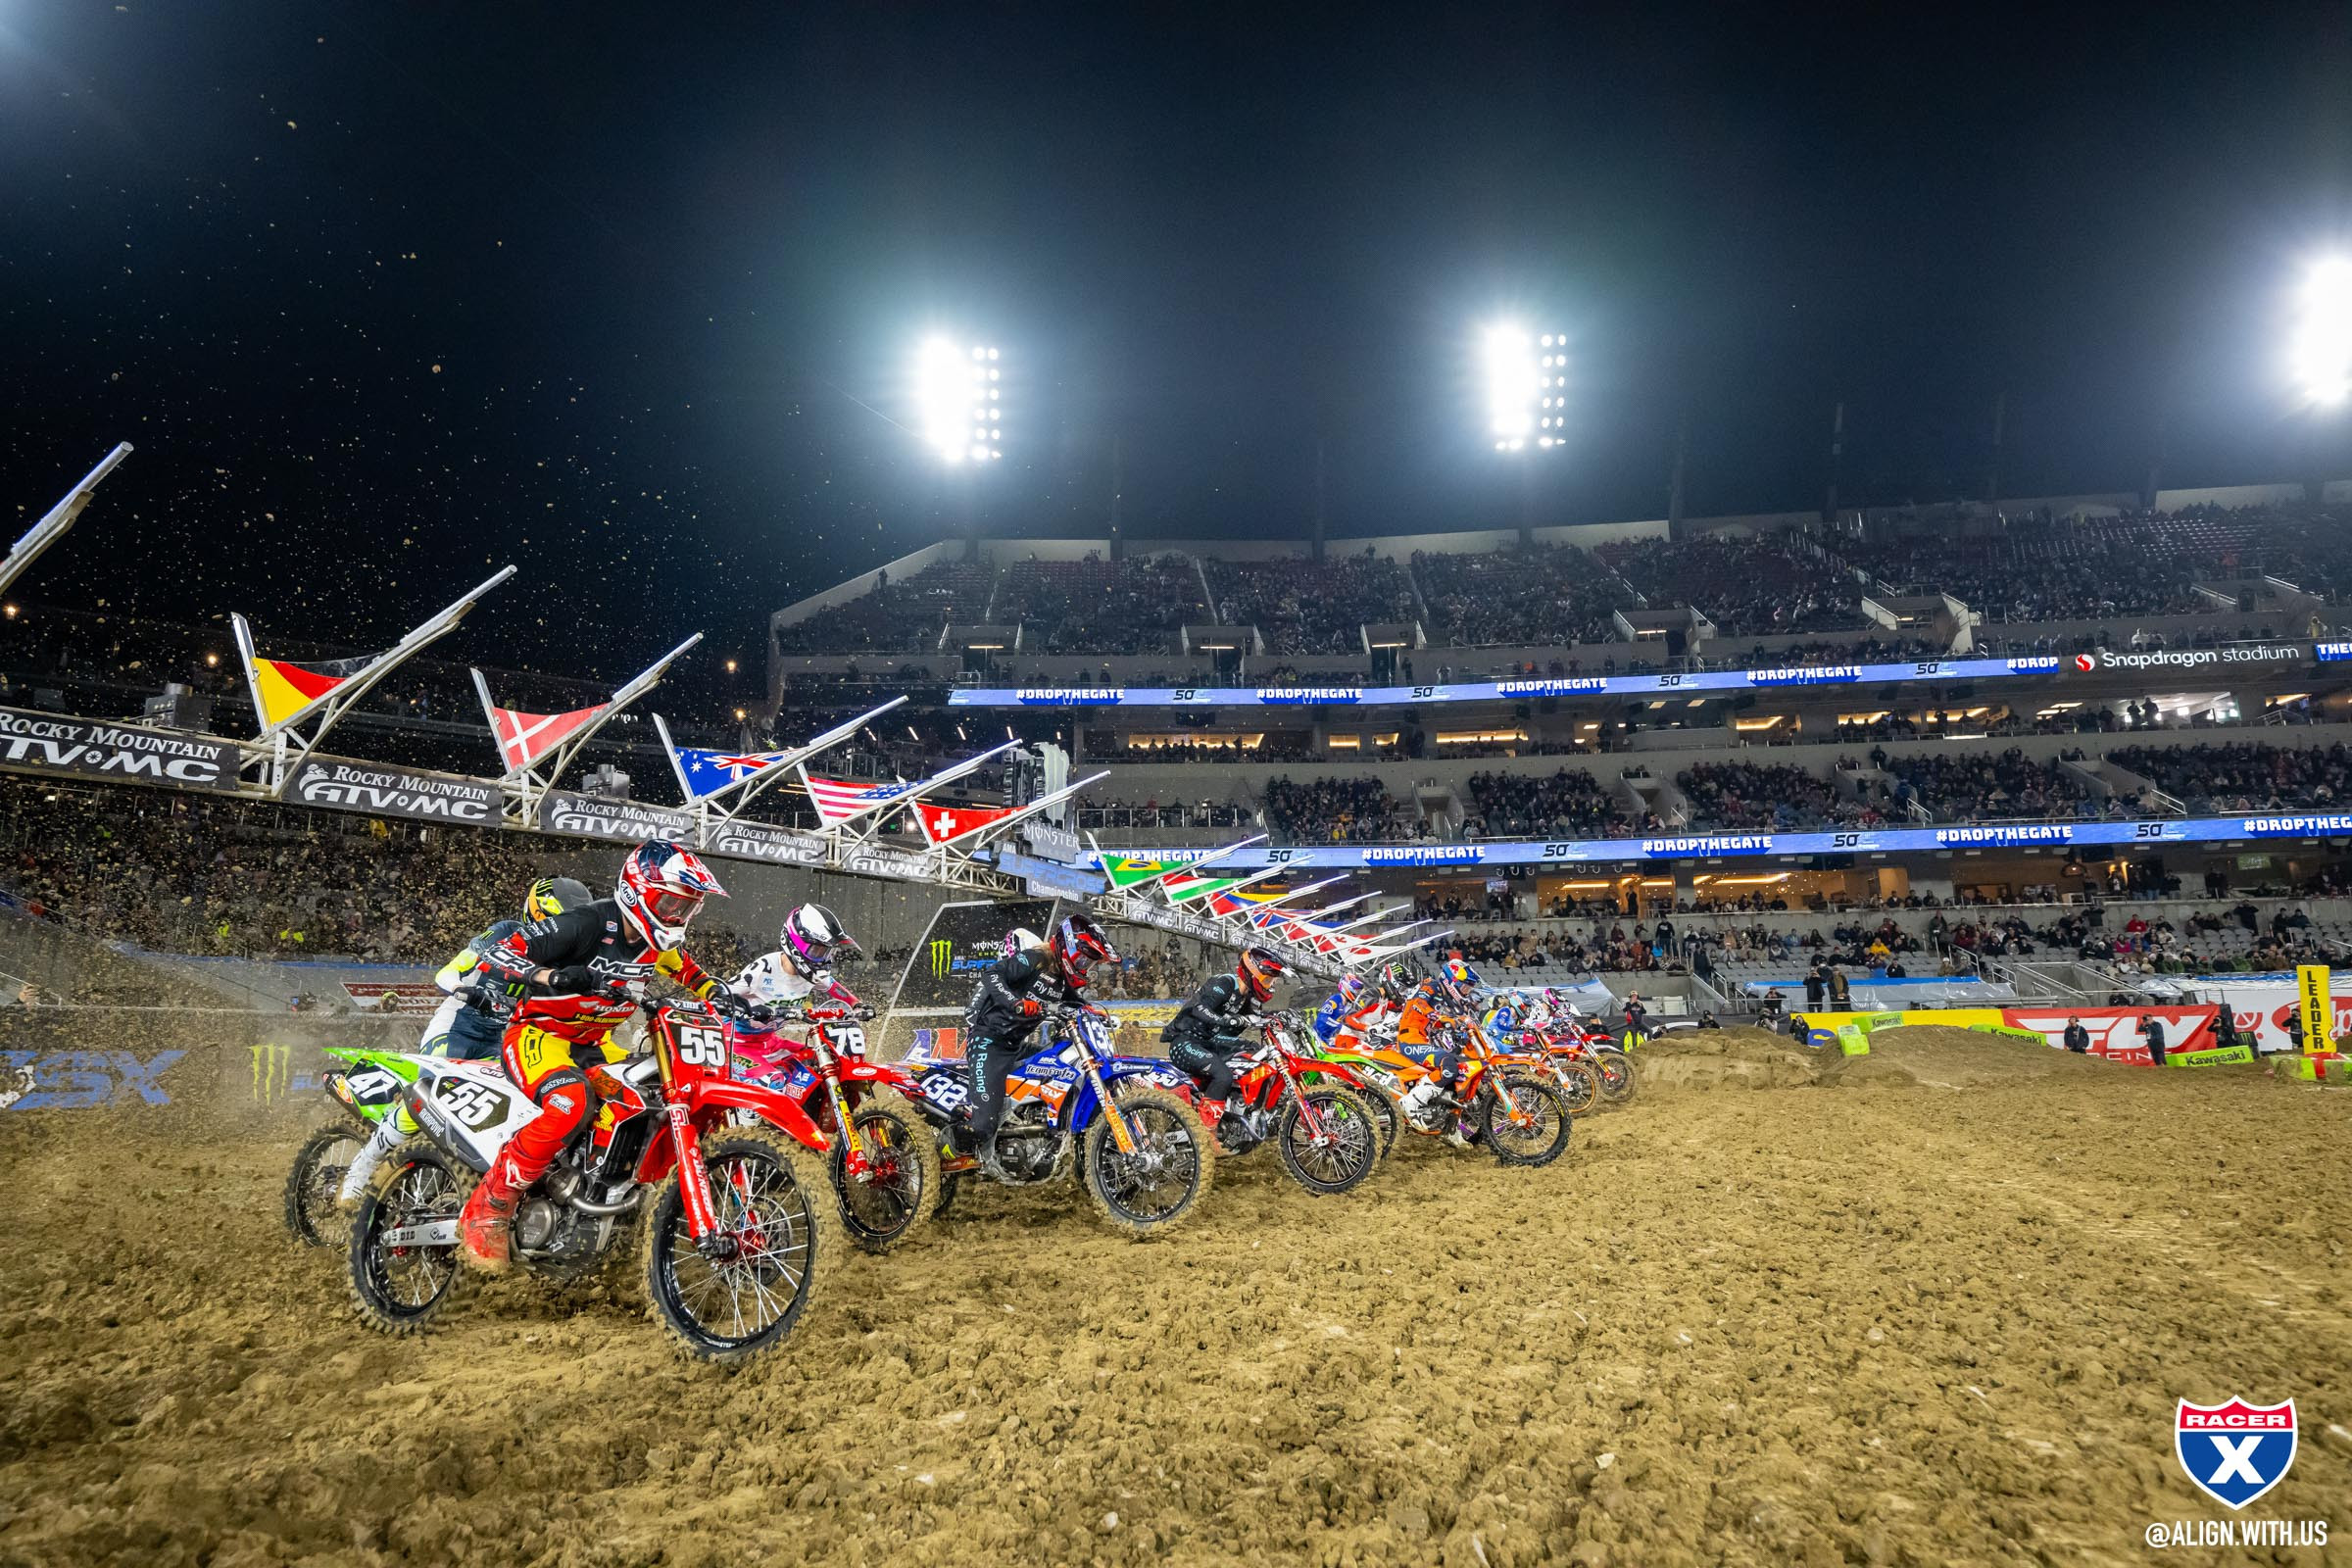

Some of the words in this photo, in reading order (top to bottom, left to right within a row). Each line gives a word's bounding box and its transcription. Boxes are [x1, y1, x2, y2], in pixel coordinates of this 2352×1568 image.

[2102, 651, 2218, 669] Snapdragon
[2223, 645, 2299, 662] stadium
[2317, 644, 2352, 656] THE
[1915, 662, 1939, 675] 50
[2007, 658, 2058, 669] #DROP
[1658, 674, 1682, 687] 50
[1746, 666, 1862, 681] #DROPTHEGATE
[1411, 686, 1435, 698] 50
[1496, 678, 1607, 692] #DROPTHEGATE
[1015, 689, 1124, 699] #DROPTHEGATE
[1256, 688, 1362, 699] #DROPTHEGATE
[0, 712, 84, 741] ROCKY
[85, 725, 221, 760] MOUNTAIN
[332, 765, 395, 788] ROCKY
[397, 774, 489, 801] MOUNTAIN
[574, 799, 618, 816] ROCKY
[620, 806, 684, 826] MOUNTAIN
[735, 824, 767, 840] ROCKY
[769, 832, 818, 850] MOUNTAIN
[1936, 825, 2073, 842] #DROPTHEGATE
[2135, 823, 2164, 837] 50
[1002, 842, 1016, 854] AMA
[1642, 836, 1773, 852] #DROPTHEGATE
[1832, 833, 1861, 847] 50
[1361, 846, 1486, 859] #DROPTHEGATE
[1542, 843, 1570, 857] 50
[621, 884, 635, 903] Arai
[588, 955, 656, 978] MCR
[1033, 980, 1048, 995] Fly
[2306, 970, 2325, 1050] LEADER
[827, 1028, 865, 1054] 78
[1990, 1027, 2042, 1045] Kawasaki
[680, 1026, 726, 1067] 55
[2185, 1050, 2246, 1066] Kawasaki
[975, 1053, 988, 1094] Racing
[1025, 1065, 1051, 1076] TEAM
[347, 1069, 398, 1100] 47
[438, 1080, 503, 1127] 55
